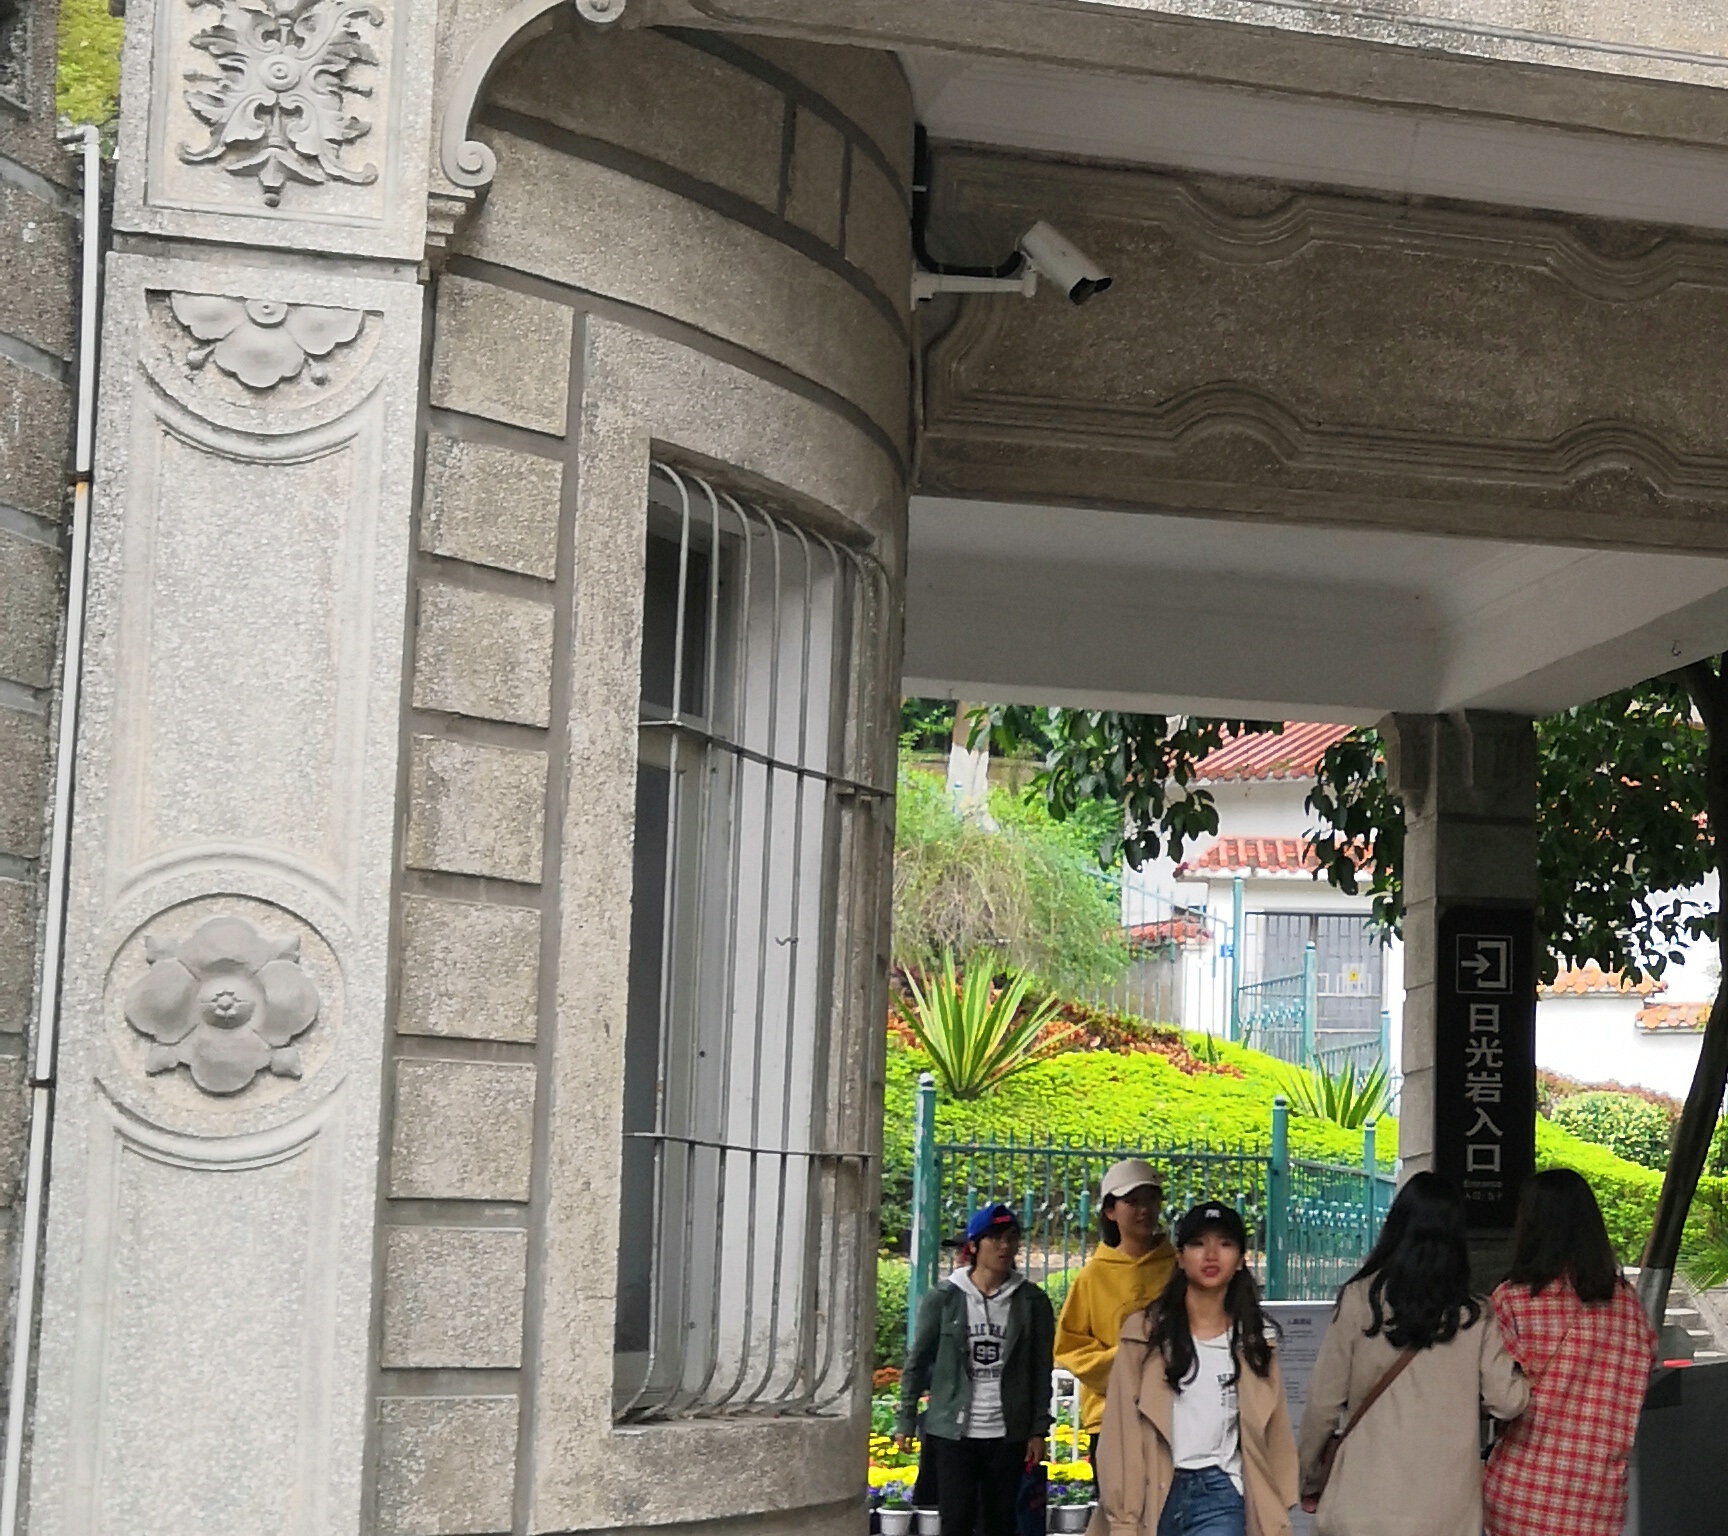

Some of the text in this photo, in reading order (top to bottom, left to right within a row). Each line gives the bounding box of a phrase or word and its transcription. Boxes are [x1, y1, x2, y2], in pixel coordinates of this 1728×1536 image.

[1465, 1003, 1504, 1172] 日光岩入口
